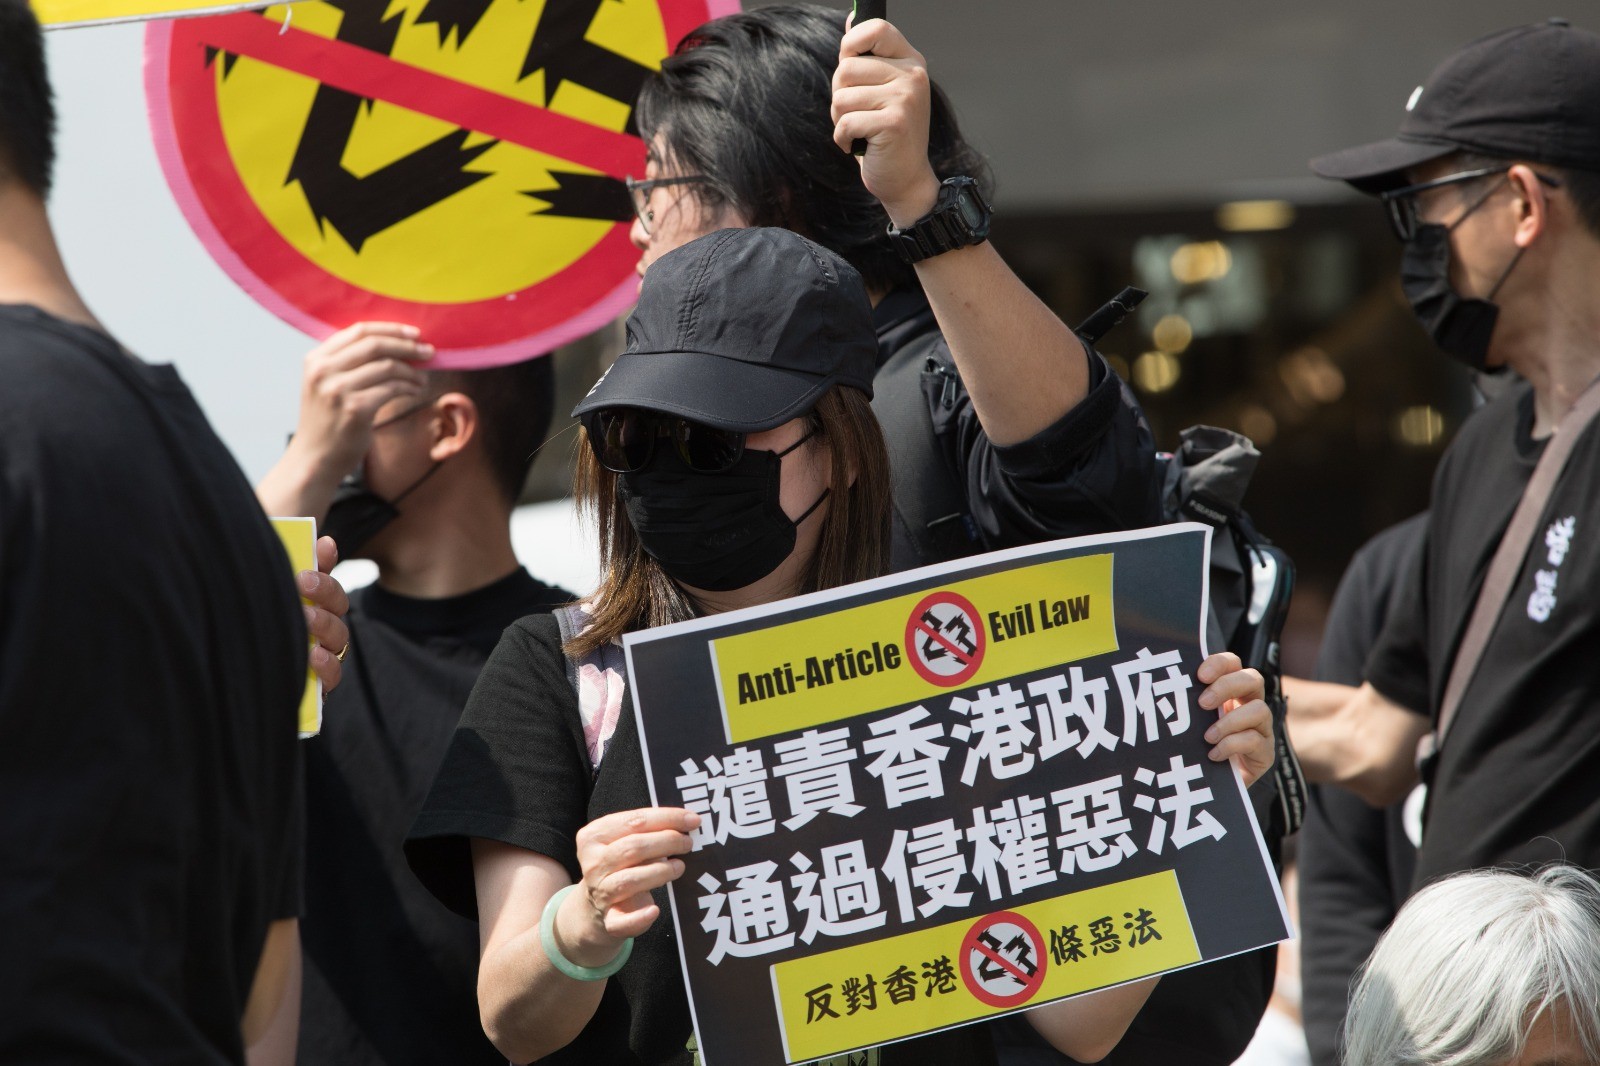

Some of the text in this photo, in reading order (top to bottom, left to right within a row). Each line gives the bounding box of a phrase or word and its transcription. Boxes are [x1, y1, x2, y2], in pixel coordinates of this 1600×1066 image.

[738, 641, 902, 705] Anti-Article
[988, 602, 1035, 643] Evil
[1039, 594, 1091, 631] Law
[675, 647, 1193, 852] 譴責香港政府
[697, 755, 1227, 967] 通過侵權惡法
[805, 954, 958, 1025] 反對香港
[1049, 908, 1163, 967] 條惡法
